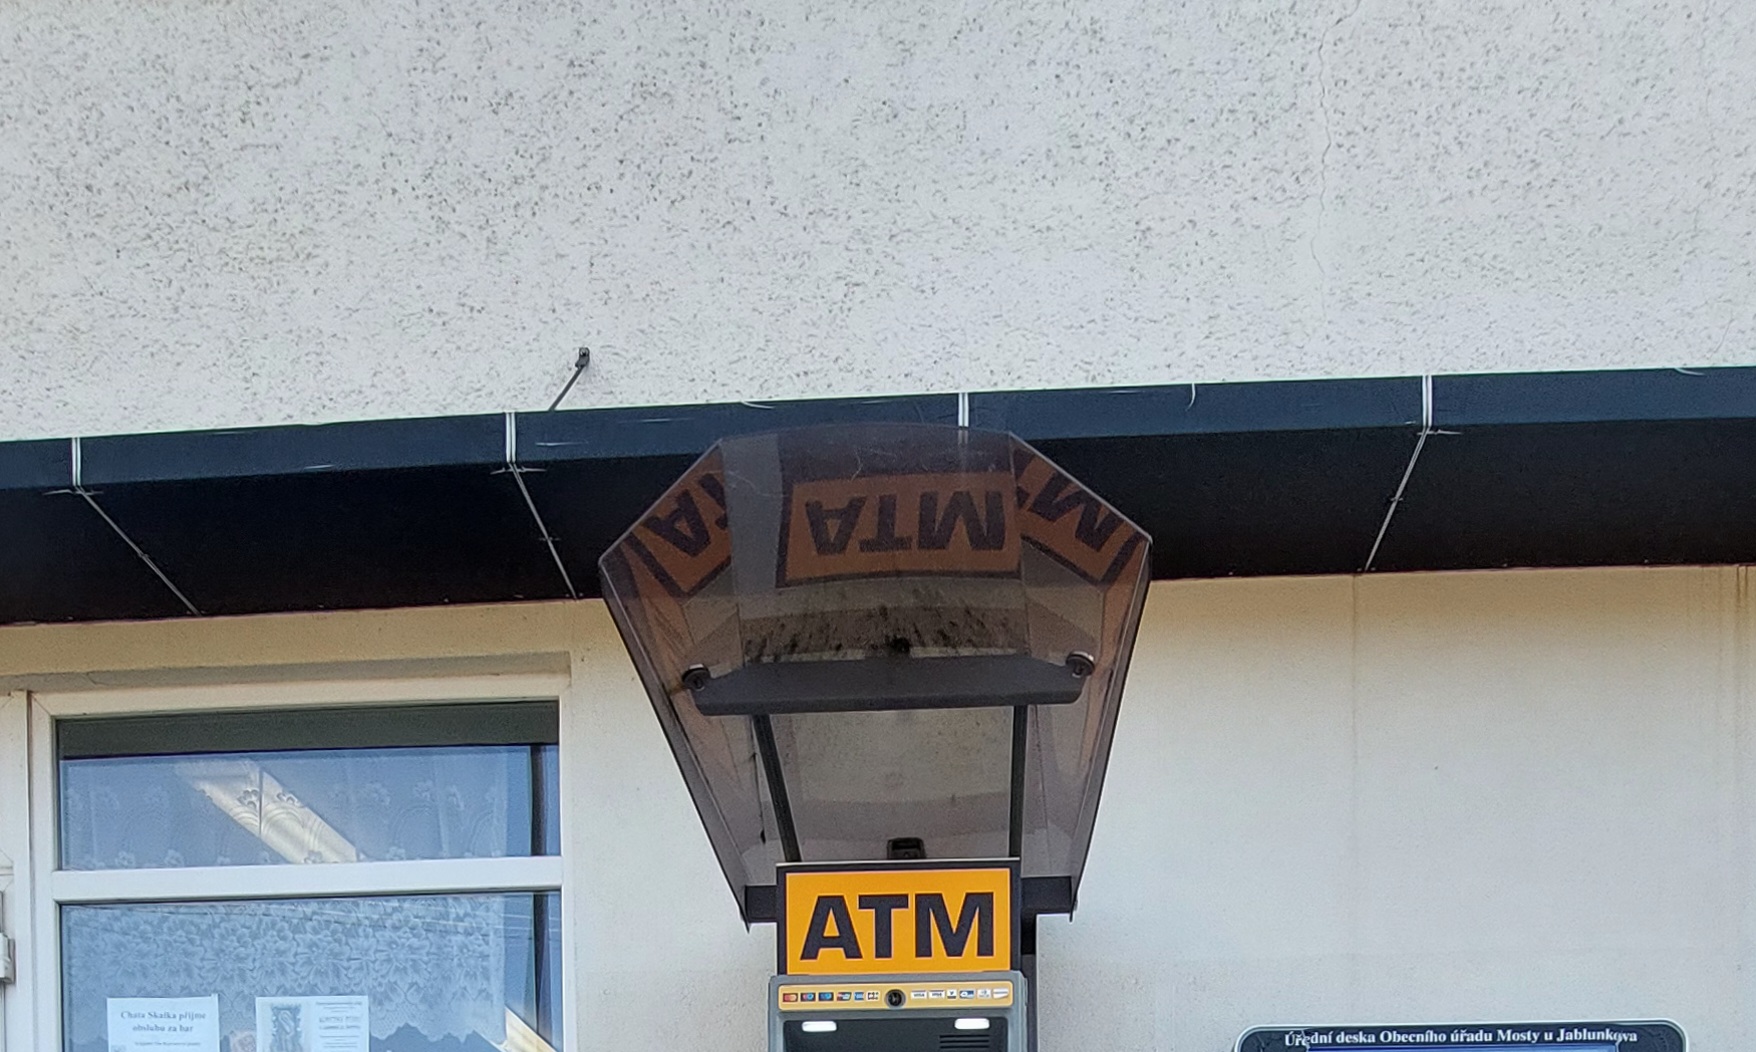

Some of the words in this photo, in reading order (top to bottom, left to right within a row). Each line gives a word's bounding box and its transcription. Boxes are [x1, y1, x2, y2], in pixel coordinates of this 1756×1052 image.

[799, 891, 996, 961] ATM
[179, 1024, 194, 1033] bar
[1285, 1031, 1333, 1046] Úřední
[1335, 1032, 1376, 1044] deska
[1379, 1030, 1448, 1044] Obecního
[1450, 1029, 1493, 1043] úřadu
[1496, 1029, 1541, 1044] Mosty
[1544, 1031, 1554, 1041] u
[1556, 1028, 1638, 1043] Jablunkova
